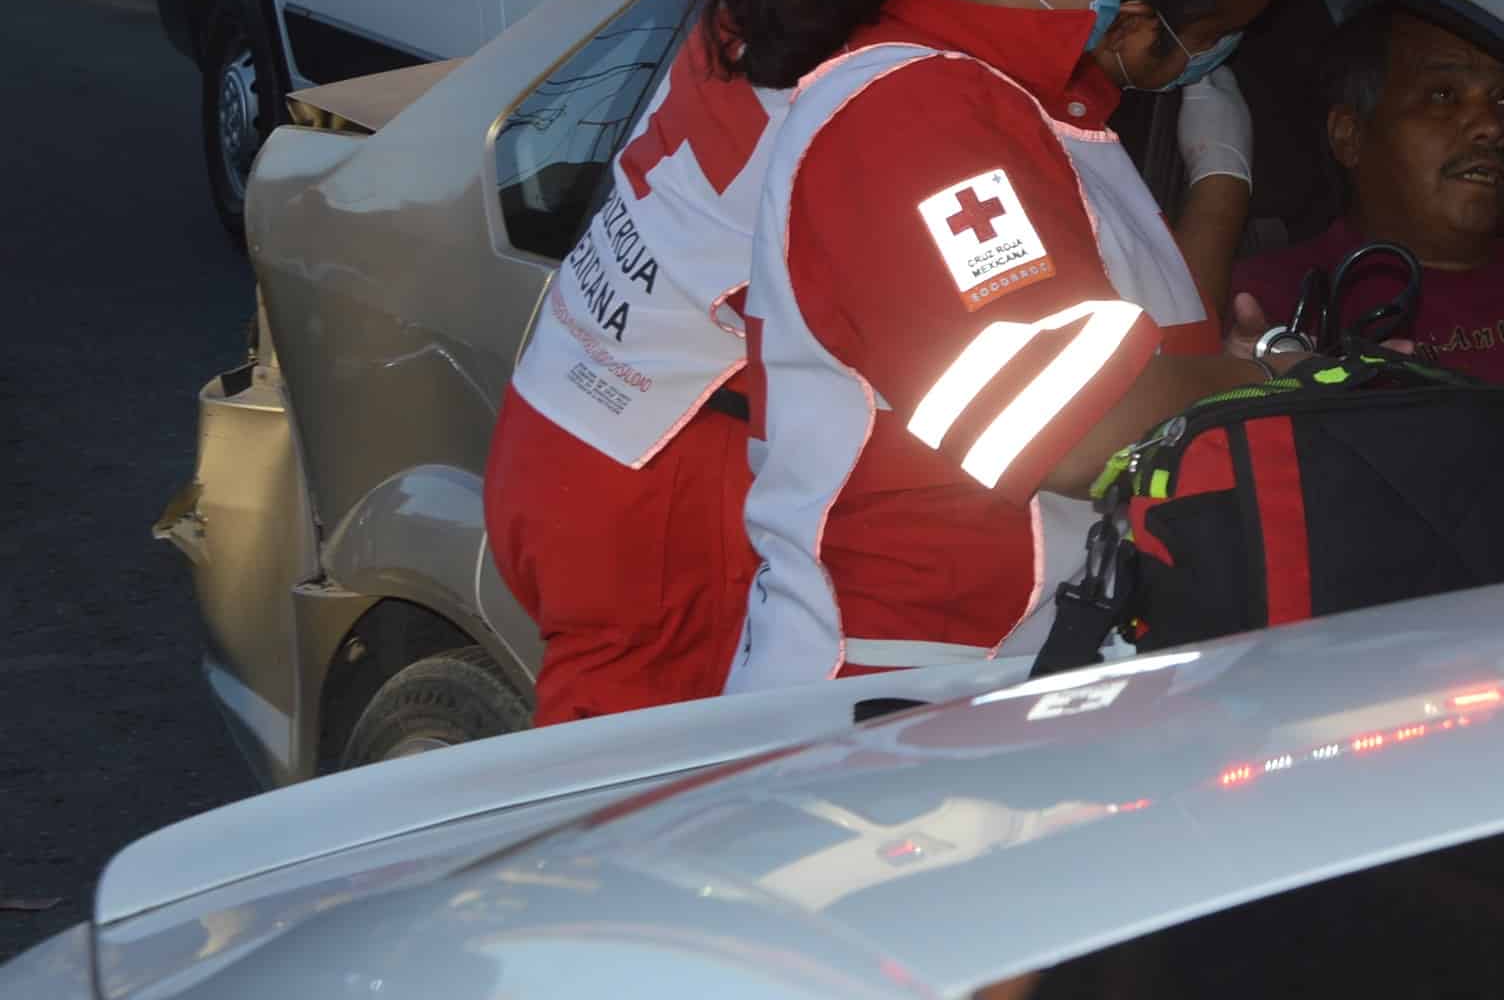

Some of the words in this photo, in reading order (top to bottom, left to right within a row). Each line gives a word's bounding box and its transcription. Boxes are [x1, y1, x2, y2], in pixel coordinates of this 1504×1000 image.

[611, 218, 659, 294] ROJA
[967, 250, 994, 268] CRUZ
[995, 238, 1024, 254] ROJA
[971, 249, 1029, 278] MEXICANA
[570, 231, 630, 342] EXICANA
